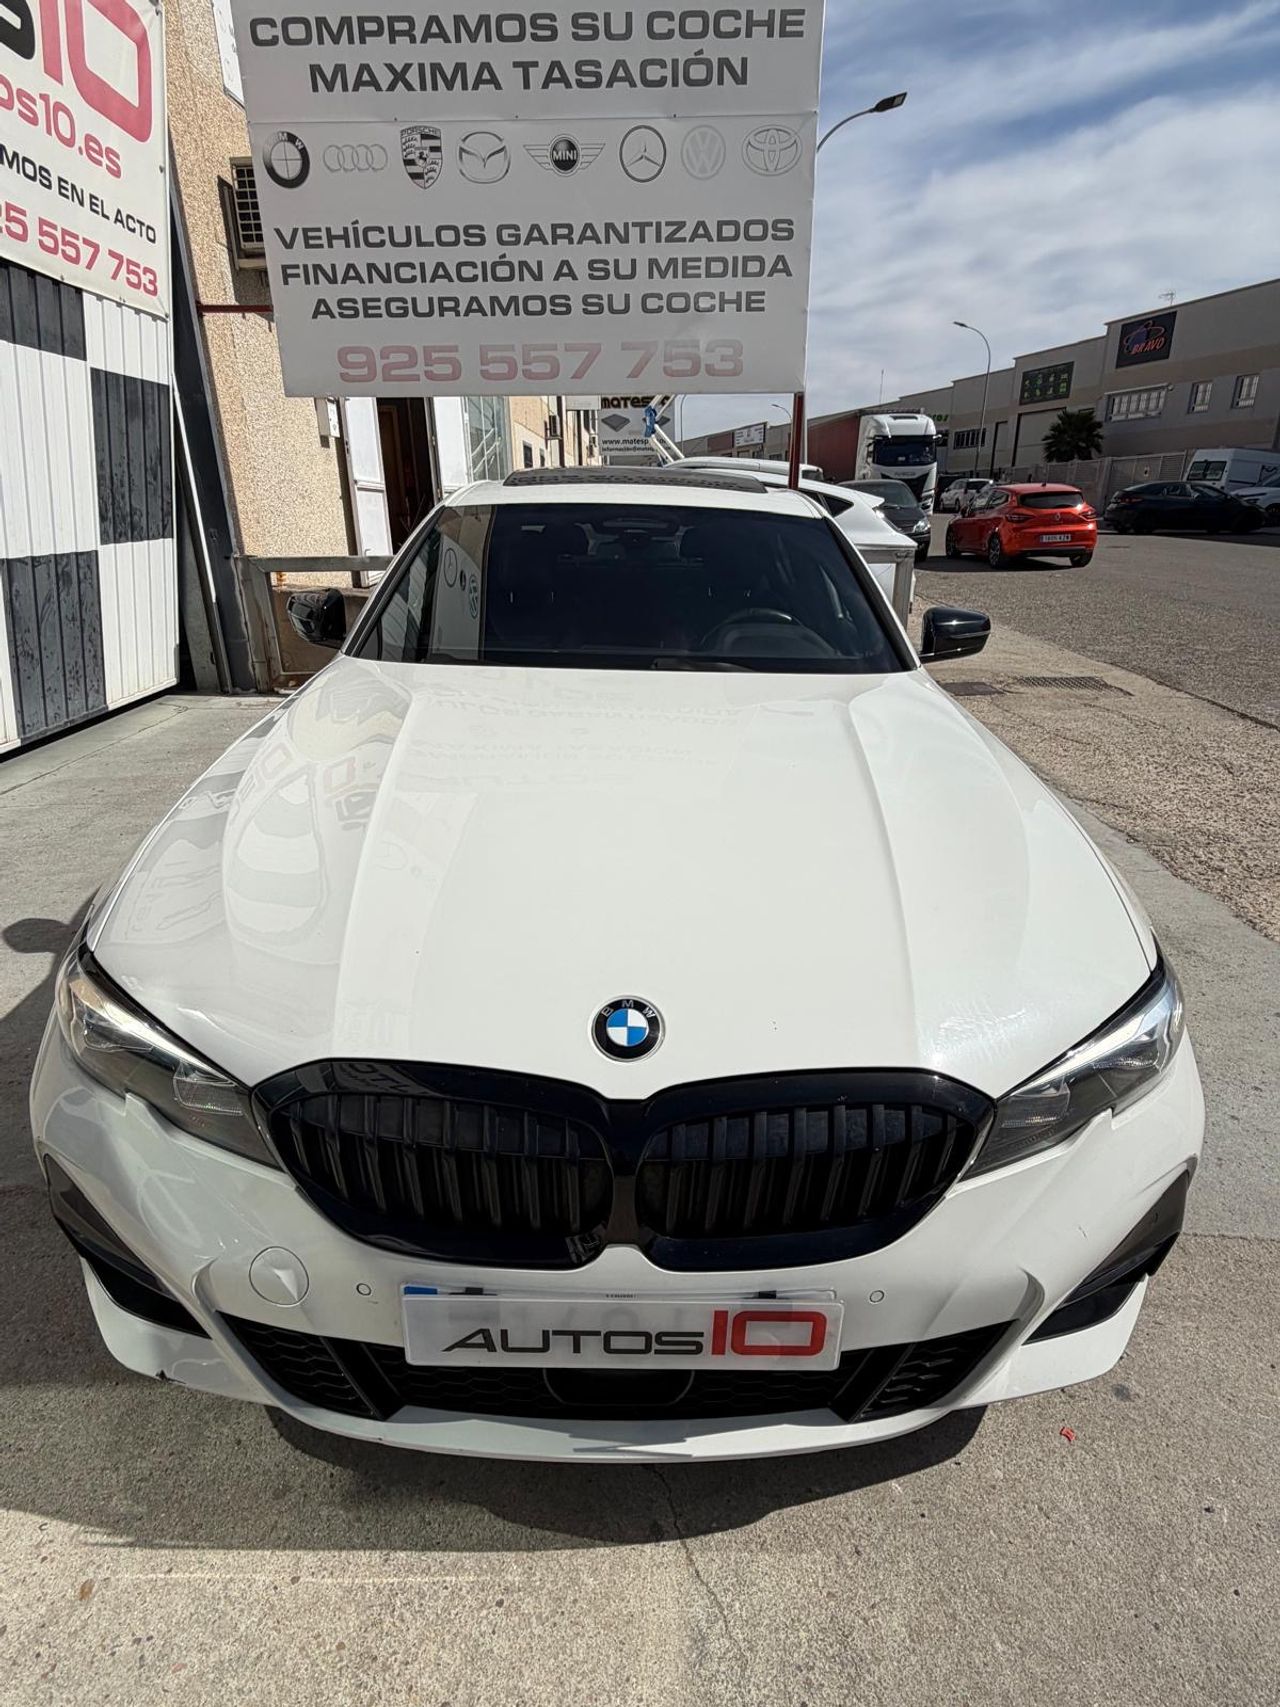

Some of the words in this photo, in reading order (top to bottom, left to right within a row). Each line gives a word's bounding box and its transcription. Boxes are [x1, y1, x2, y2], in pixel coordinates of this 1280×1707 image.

[250, 12, 558, 47] COMPRAMOS
[571, 11, 633, 42] SU
[646, 9, 805, 41] COCHE
[309, 61, 503, 93] MAXIMA
[513, 48, 748, 90] TASACIÓN
[552, 150, 578, 161] MINI
[0, 143, 52, 190] MOS
[57, 175, 84, 208] EN
[89, 193, 110, 220] EL
[114, 208, 156, 244] ACTO
[0, 201, 28, 242] 5
[38, 216, 101, 271] 557
[108, 248, 158, 297] 753
[273, 219, 486, 250] VEHÍCULOS
[496, 218, 794, 246] GARANTIZADOS
[280, 253, 543, 286] FINANCIACIÓN
[553, 259, 578, 281] A
[587, 258, 637, 280] SU
[648, 254, 792, 279] MEDIDA
[311, 294, 572, 319] ASEGURAMOS
[582, 293, 630, 315] SU
[641, 291, 766, 314] COCHE
[337, 344, 462, 383] 925
[479, 342, 602, 381] 557
[621, 338, 743, 379] 753
[601, 1000, 656, 1018] BMW
